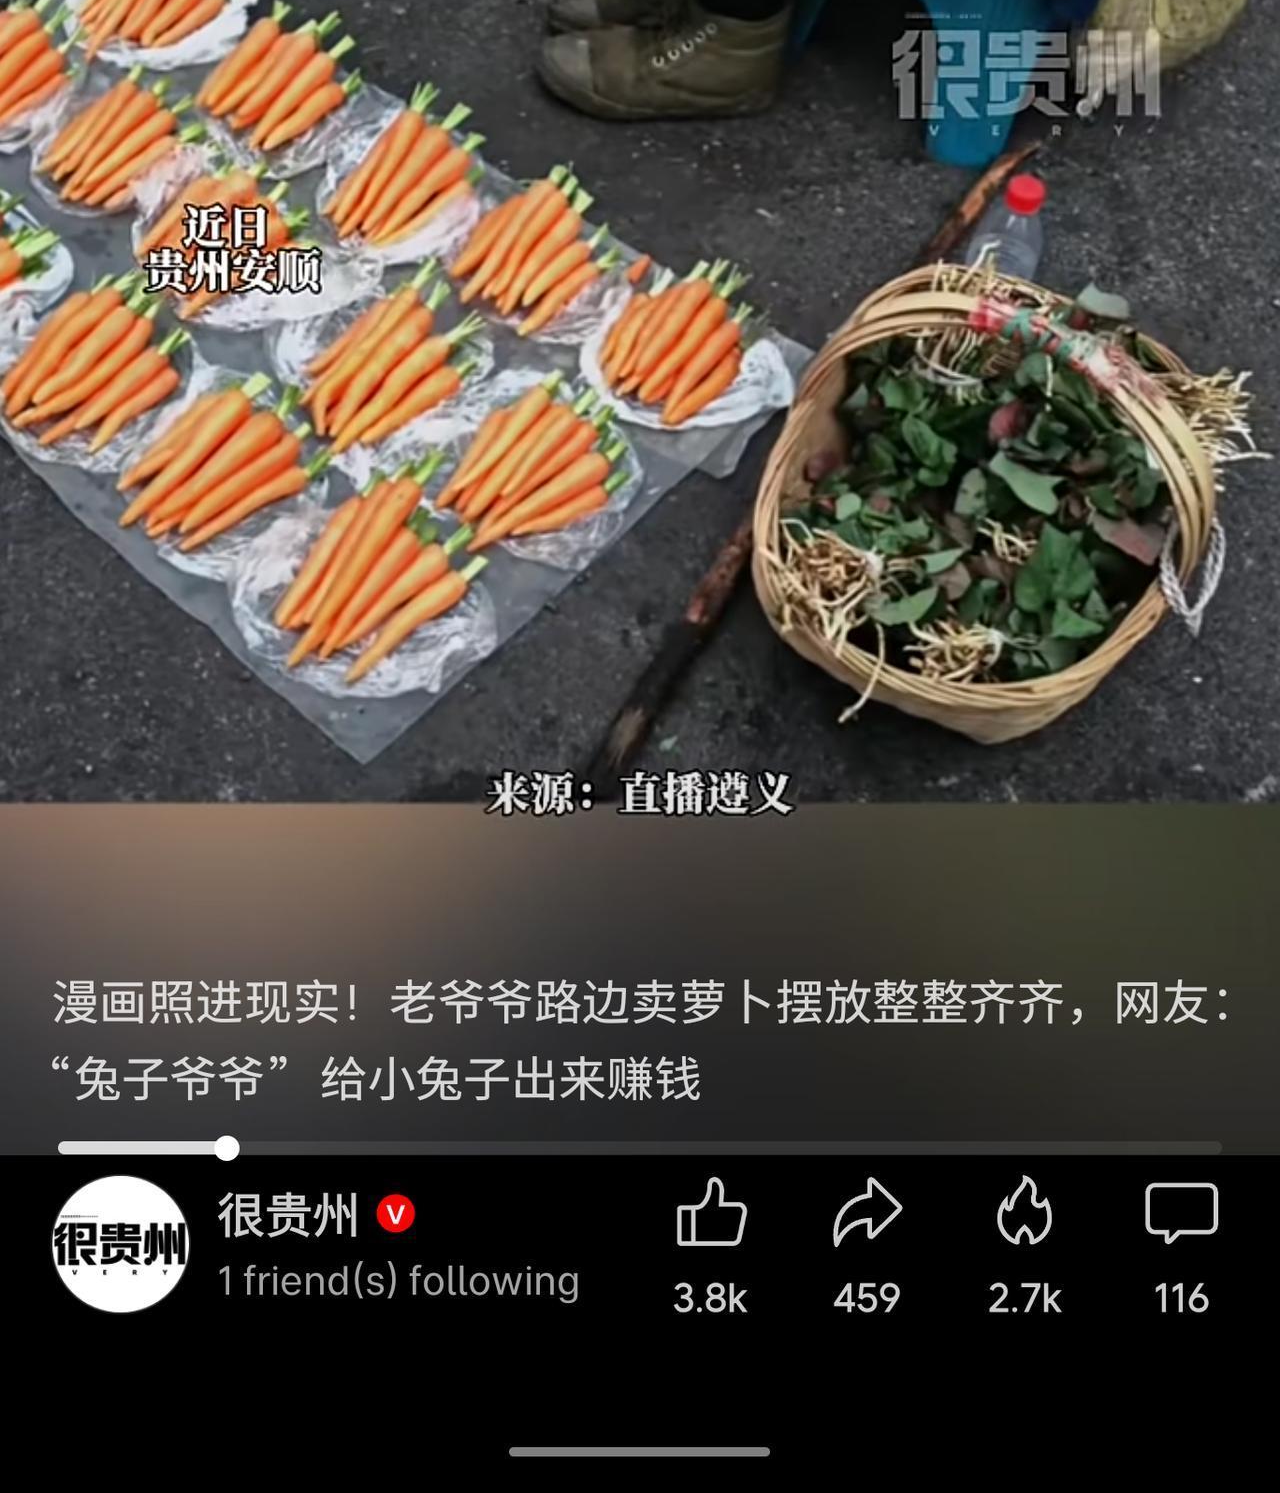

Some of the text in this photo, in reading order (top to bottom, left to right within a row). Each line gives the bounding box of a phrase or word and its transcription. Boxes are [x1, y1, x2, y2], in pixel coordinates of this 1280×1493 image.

[217, 1191, 358, 1239] 很贵州
[54, 1222, 186, 1266] 很贵州
[219, 1260, 579, 1304] 1 friend(s) following
[673, 1282, 748, 1313] 3.8k
[833, 1282, 901, 1313] 459
[988, 1282, 1063, 1313] 2.7k
[1155, 1282, 1210, 1313] 116
